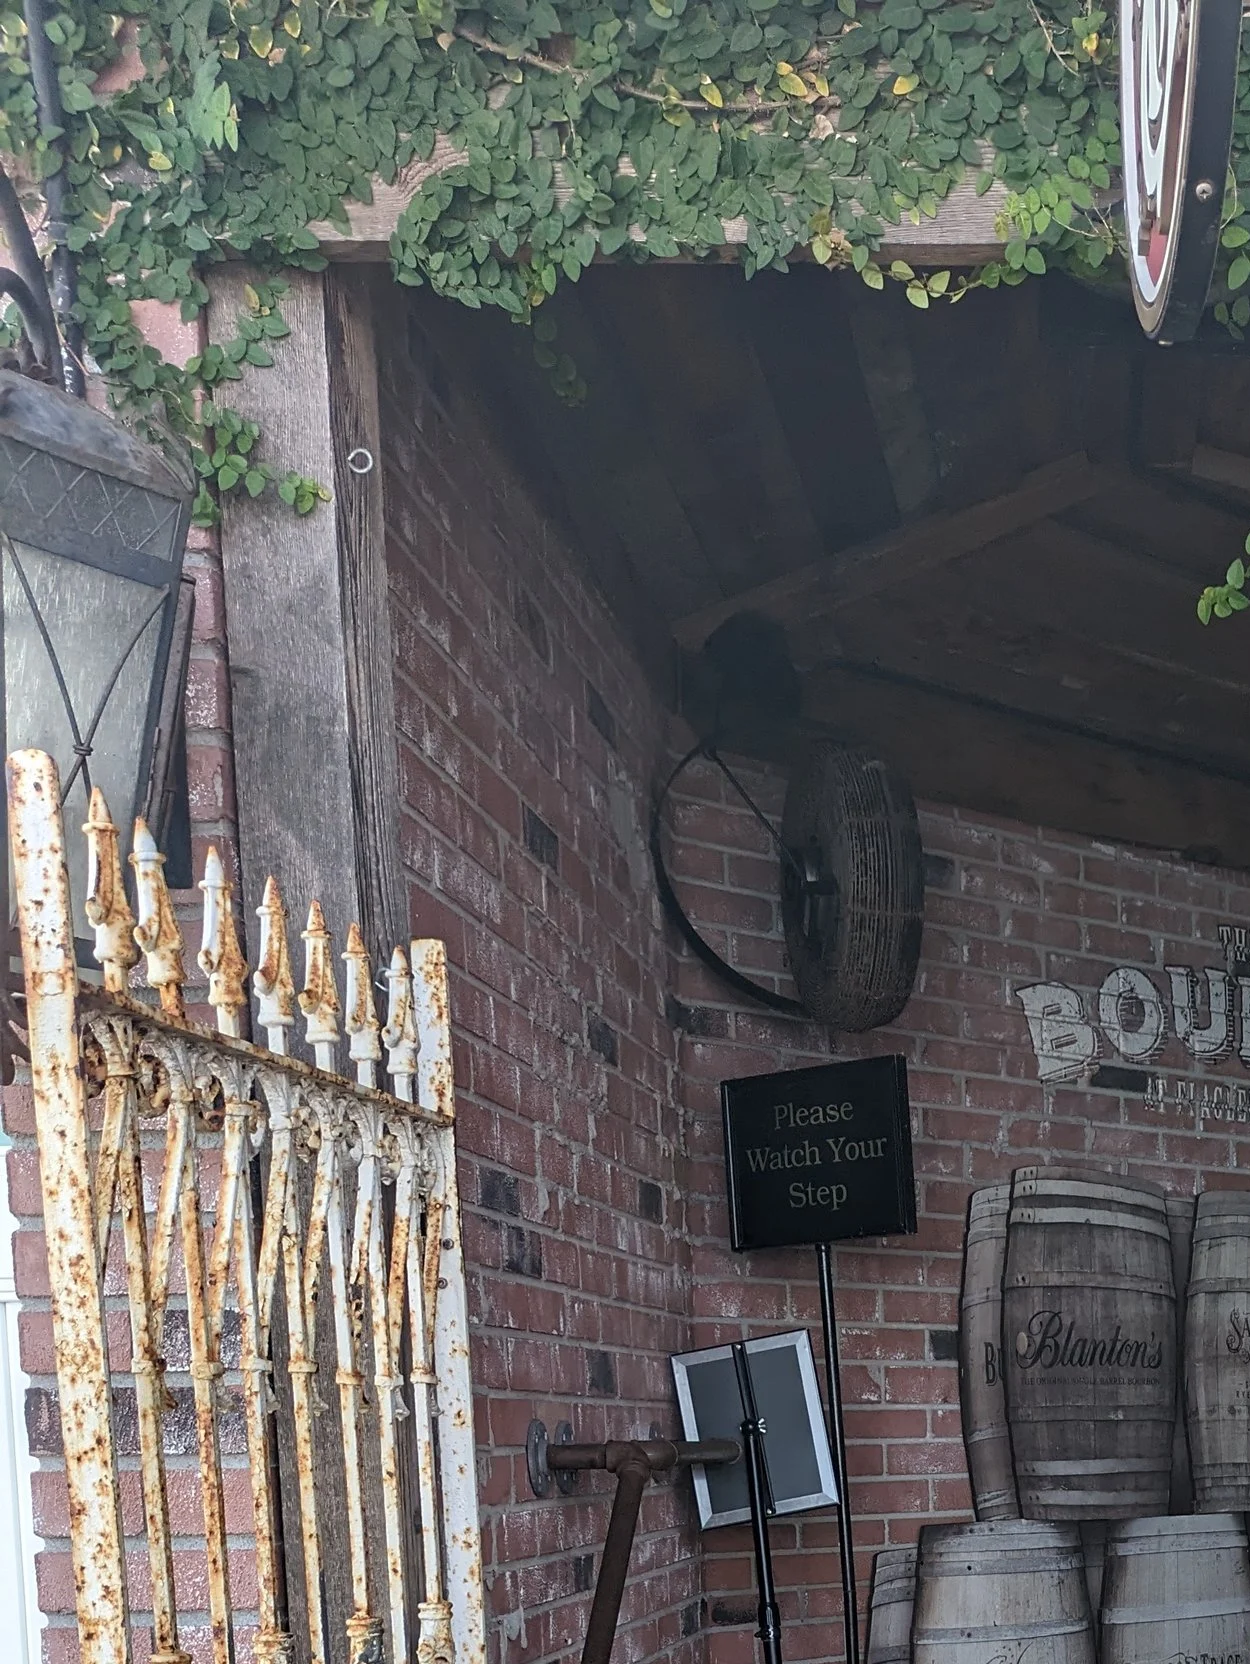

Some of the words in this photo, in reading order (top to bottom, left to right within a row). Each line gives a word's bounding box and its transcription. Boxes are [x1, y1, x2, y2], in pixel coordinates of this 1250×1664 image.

[1143, 1076, 1168, 1115] AT
[773, 1101, 854, 1131] Please
[746, 1140, 822, 1173] Watch
[825, 1136, 888, 1163] Your
[789, 1182, 848, 1212] Step
[1015, 1310, 1163, 1369] Blanton's
